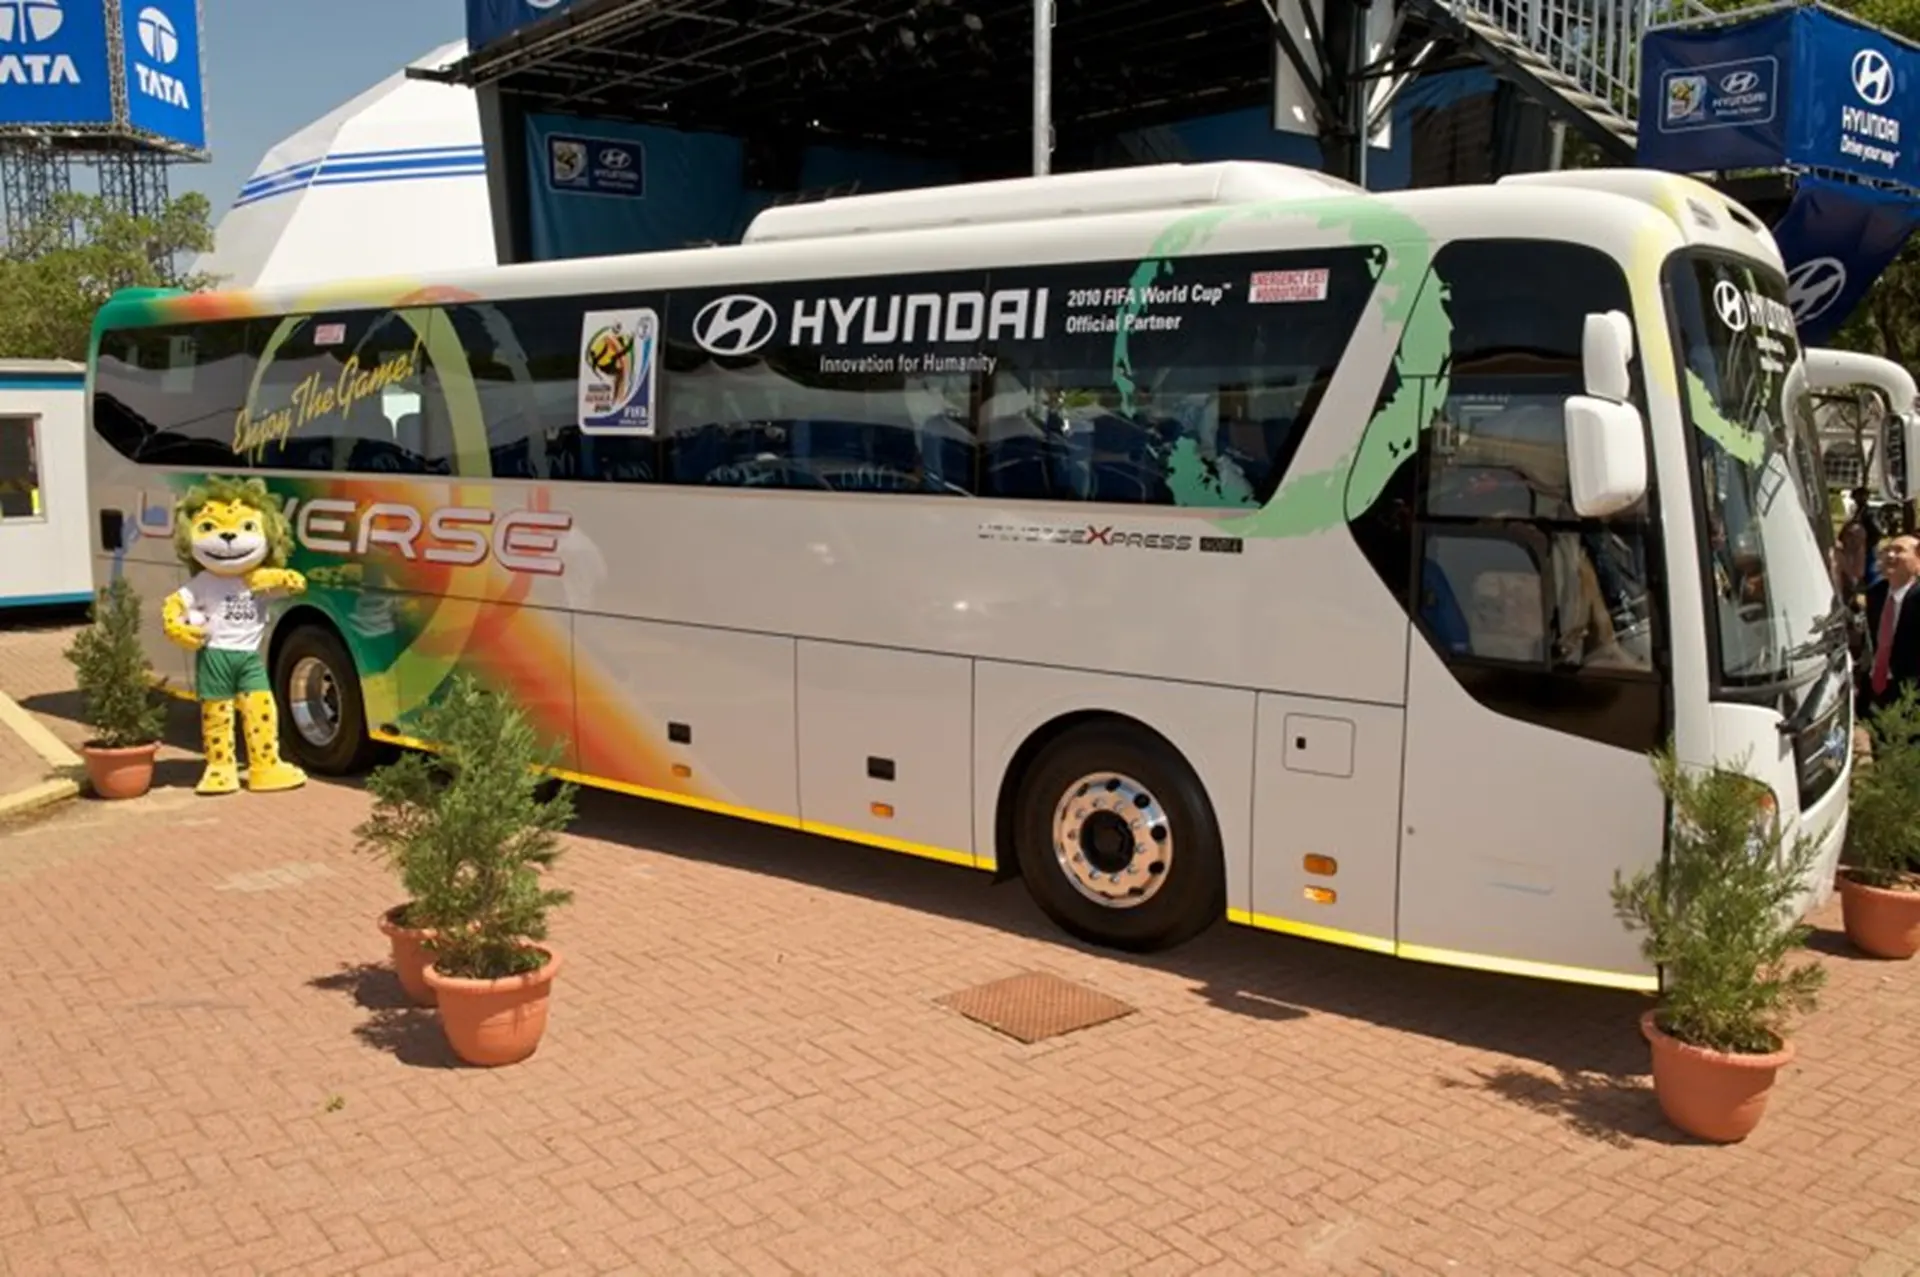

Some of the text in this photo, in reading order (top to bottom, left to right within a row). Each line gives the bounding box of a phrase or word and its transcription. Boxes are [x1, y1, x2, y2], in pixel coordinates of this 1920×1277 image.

[0, 54, 81, 84] ATA
[134, 62, 190, 110] TATA
[1842, 104, 1899, 144] HYUNDAI
[1067, 289, 1101, 307] 2010
[1104, 287, 1136, 306] FIFA
[1140, 285, 1188, 304] World
[790, 288, 1049, 346] HYUNDAI
[1065, 313, 1183, 333] Official Partner
[820, 352, 997, 375] Innovation for Humanity
[232, 337, 422, 463] Enjoy The Game!
[136, 490, 574, 577] UERSE
